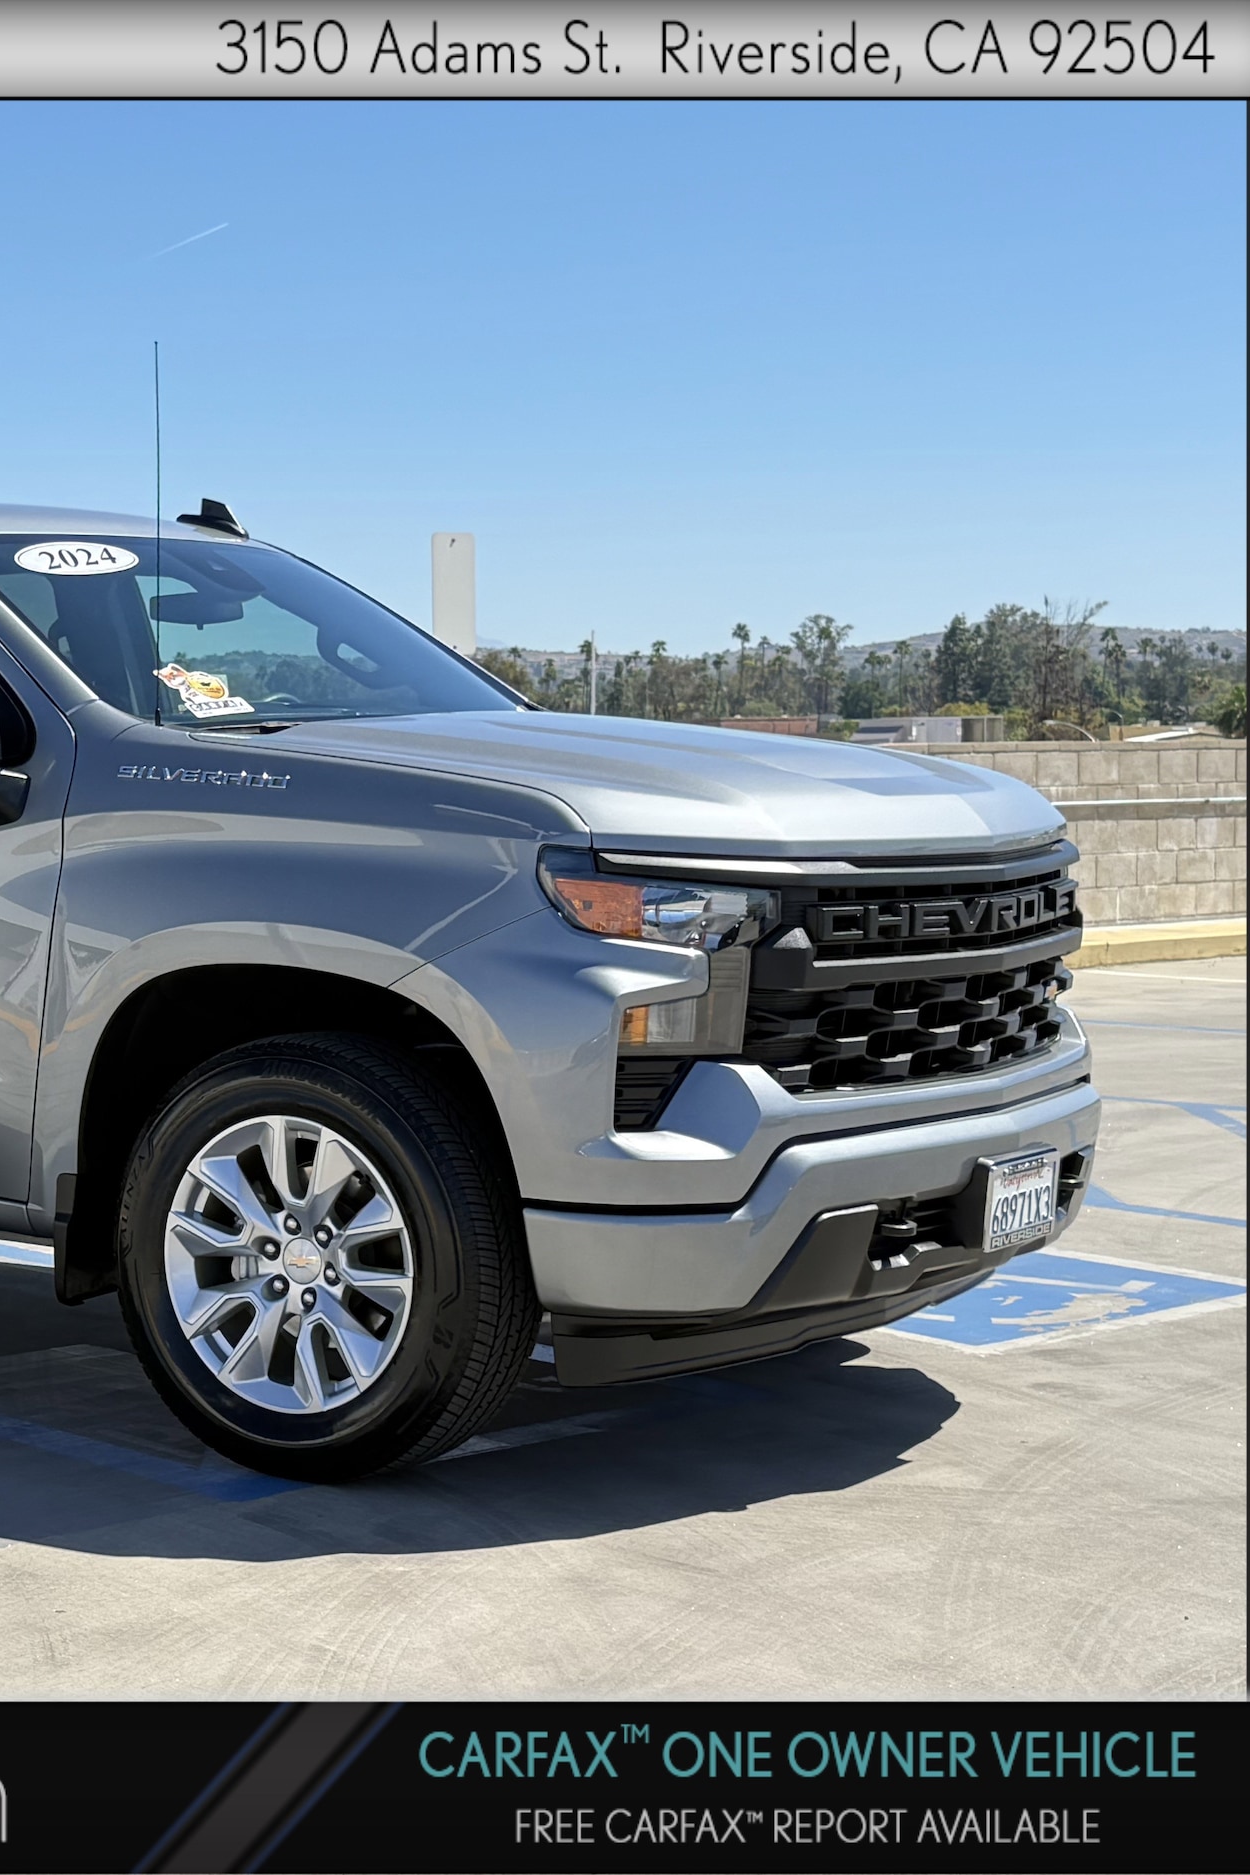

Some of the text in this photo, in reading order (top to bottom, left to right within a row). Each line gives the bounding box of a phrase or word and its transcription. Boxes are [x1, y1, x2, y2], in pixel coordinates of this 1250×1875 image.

[38, 546, 117, 570] 2024
[117, 765, 291, 789] SILVERADO
[814, 880, 1078, 941] CHEVROLE
[991, 1185, 1052, 1235] 68971X3
[991, 1223, 1051, 1249] RIVERSIDE
